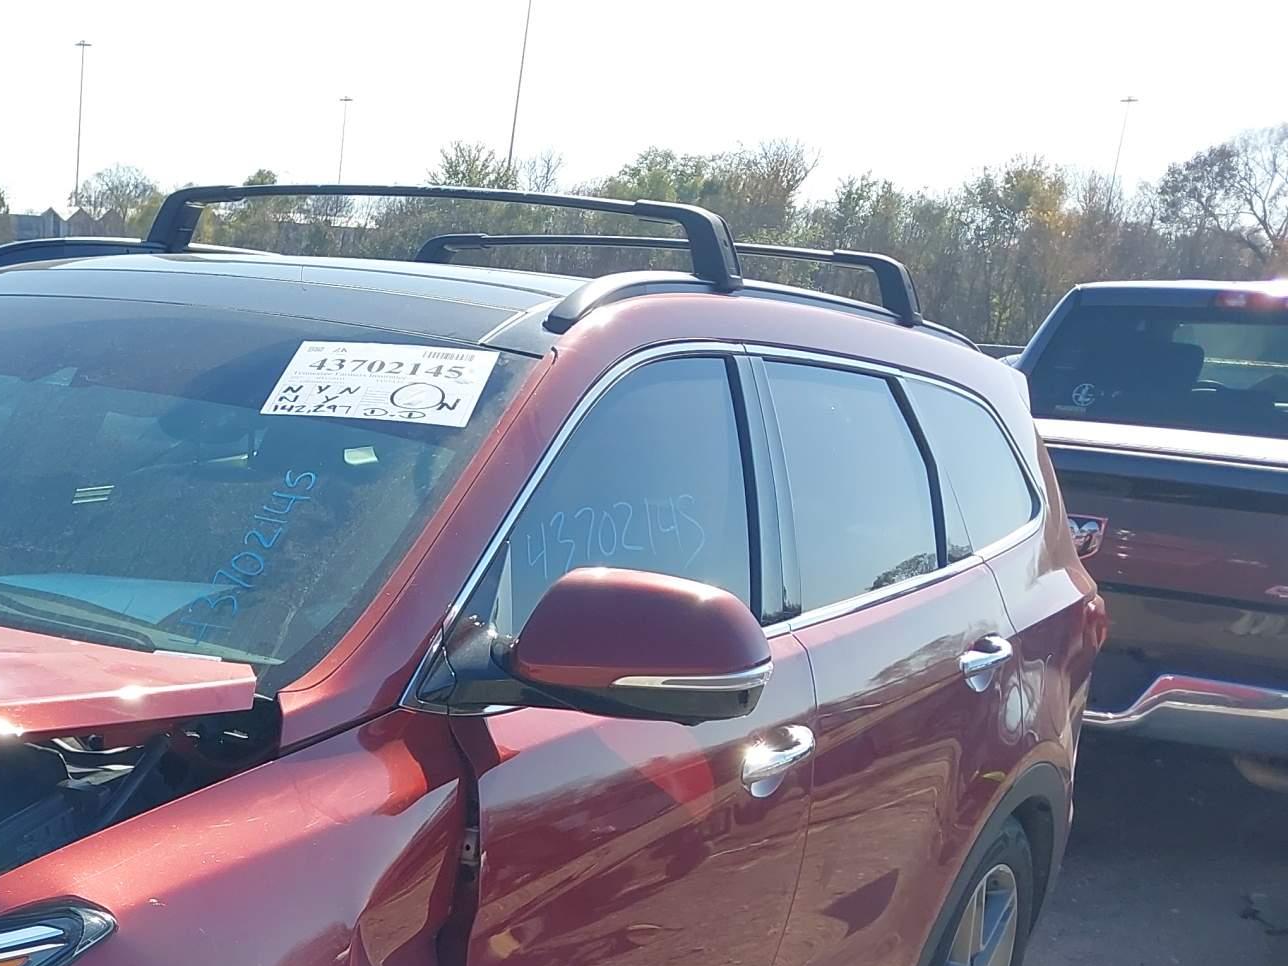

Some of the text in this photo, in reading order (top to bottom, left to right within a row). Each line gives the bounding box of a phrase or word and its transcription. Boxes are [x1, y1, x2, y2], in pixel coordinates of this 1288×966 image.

[308, 357, 466, 379] 43702145
[316, 384, 332, 395] Y
[167, 469, 317, 647] 43702145
[526, 494, 705, 580] 43702145
